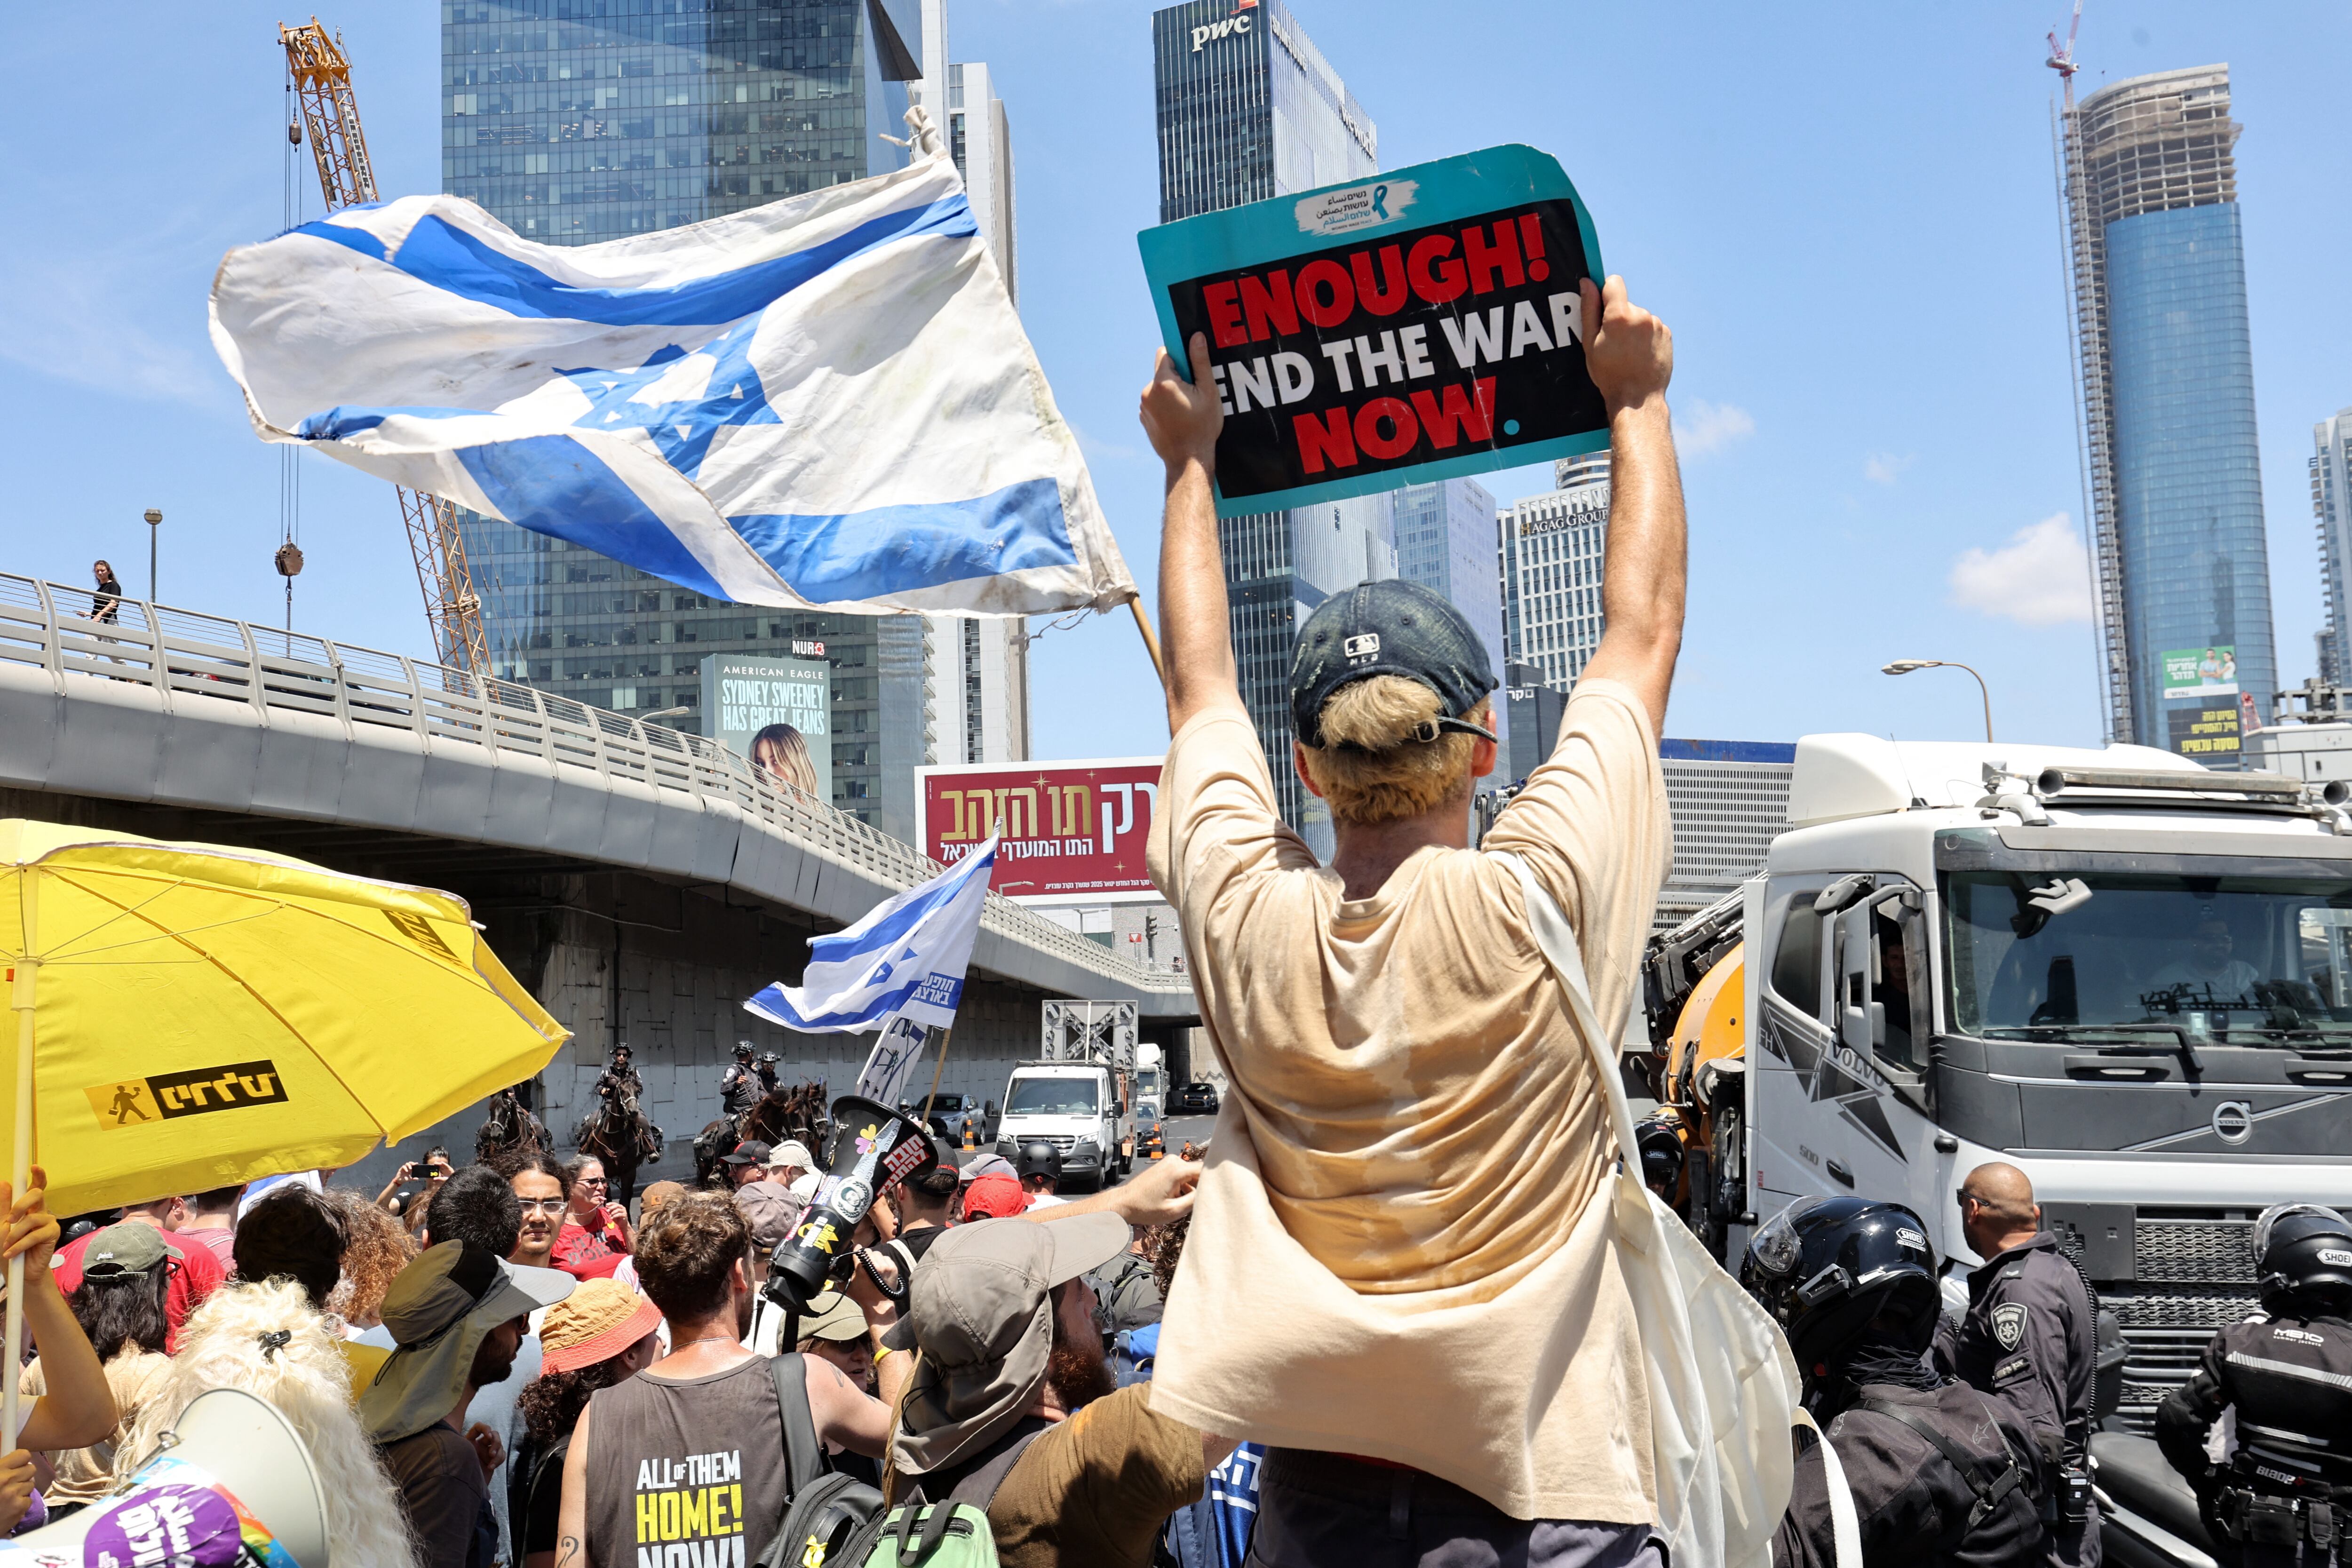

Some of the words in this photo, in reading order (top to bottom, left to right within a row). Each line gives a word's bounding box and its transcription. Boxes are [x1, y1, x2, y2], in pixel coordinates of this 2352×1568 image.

[1191, 15, 1250, 53] pwc
[346, 111, 370, 189] LIEBHERR
[1348, 191, 1367, 200] נשים
[1351, 210, 1371, 220] שלום
[1203, 213, 1550, 349] ENOUGH!
[1323, 323, 1436, 393] THE
[1440, 292, 1583, 368] WAR
[1520, 517, 1565, 535] HAGAG
[1350, 653, 1378, 665] MLB
[723, 666, 784, 677] AMERICAN
[790, 670, 823, 679] EAGLE
[722, 679, 769, 706] SYDNEY
[771, 682, 825, 709] SWEENEY
[723, 706, 747, 731] HAS
[750, 707, 786, 732] GREAT
[789, 709, 825, 735] JEANS
[2212, 737, 2240, 751] עסקה
[940, 787, 1038, 841] הזהב
[1047, 785, 1092, 836] תו
[1100, 782, 1158, 854] רק
[940, 842, 999, 861] ראל
[1002, 840, 1060, 861] המועדף
[1065, 839, 1093, 856] התו
[920, 974, 956, 992] חופש
[912, 986, 950, 1005] בארצנ
[1759, 1027, 1773, 1051] FH
[1832, 1040, 1886, 1086] VOLVO
[882, 1134, 926, 1172] חובה
[1799, 1144, 1819, 1166] 500
[877, 1148, 928, 1197] להתנגד
[1901, 1230, 1923, 1243] SHOEI
[2325, 1253, 2351, 1263] SHOEI
[2274, 1328, 2324, 1343] MB10
[636, 1458, 677, 1490] ALL
[674, 1463, 687, 1480] OF
[686, 1449, 741, 1486] THEM
[636, 1484, 743, 1543] HOME!
